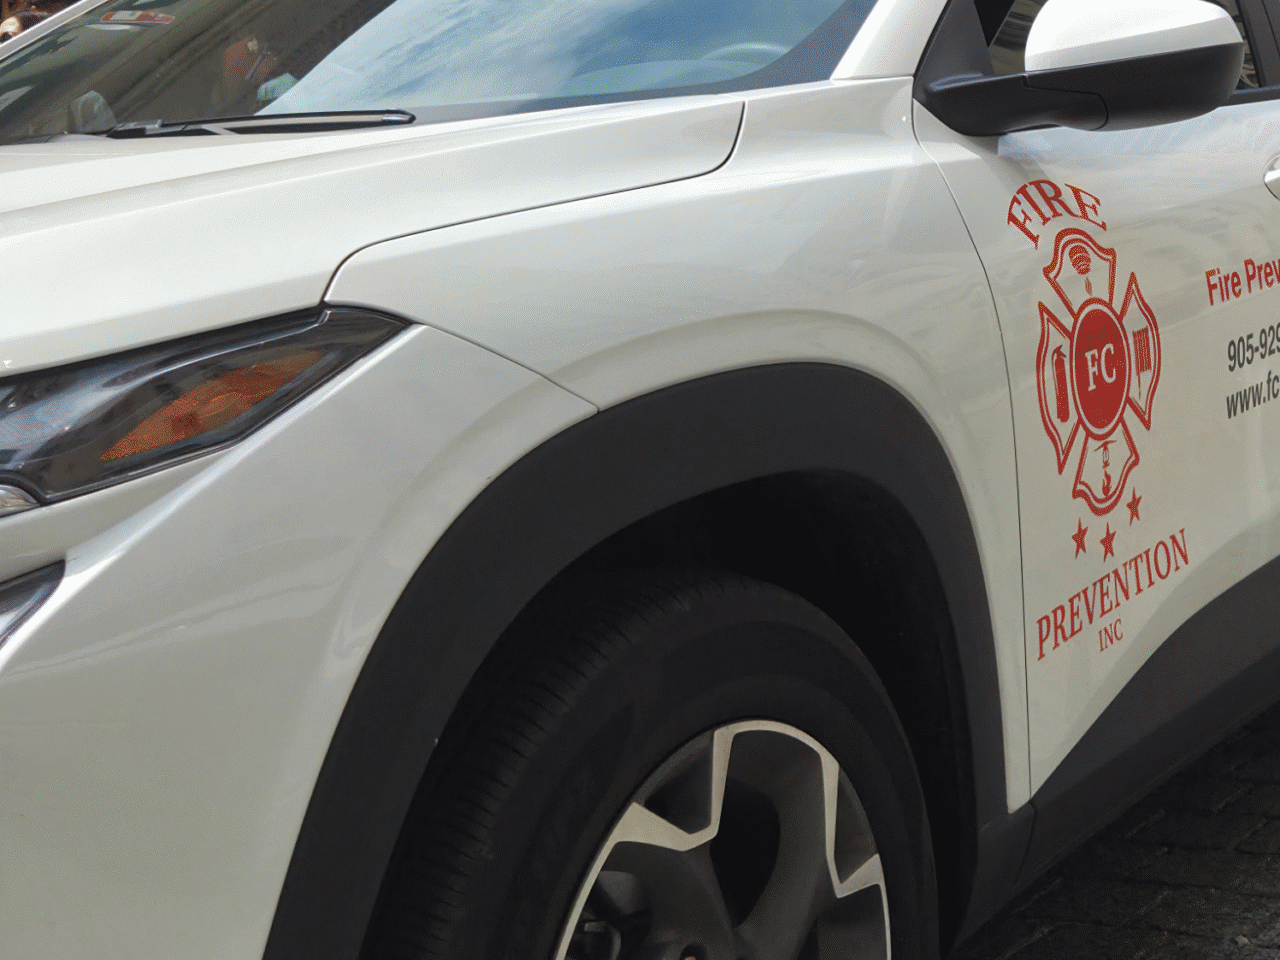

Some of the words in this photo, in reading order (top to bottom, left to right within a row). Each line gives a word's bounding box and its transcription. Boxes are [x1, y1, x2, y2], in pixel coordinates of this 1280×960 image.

[1007, 179, 1108, 250] FIRE
[1205, 267, 1242, 306] Fire
[1084, 342, 1117, 391] FC
[1036, 528, 1189, 661] PREVENTION
[1098, 618, 1123, 652] INC
